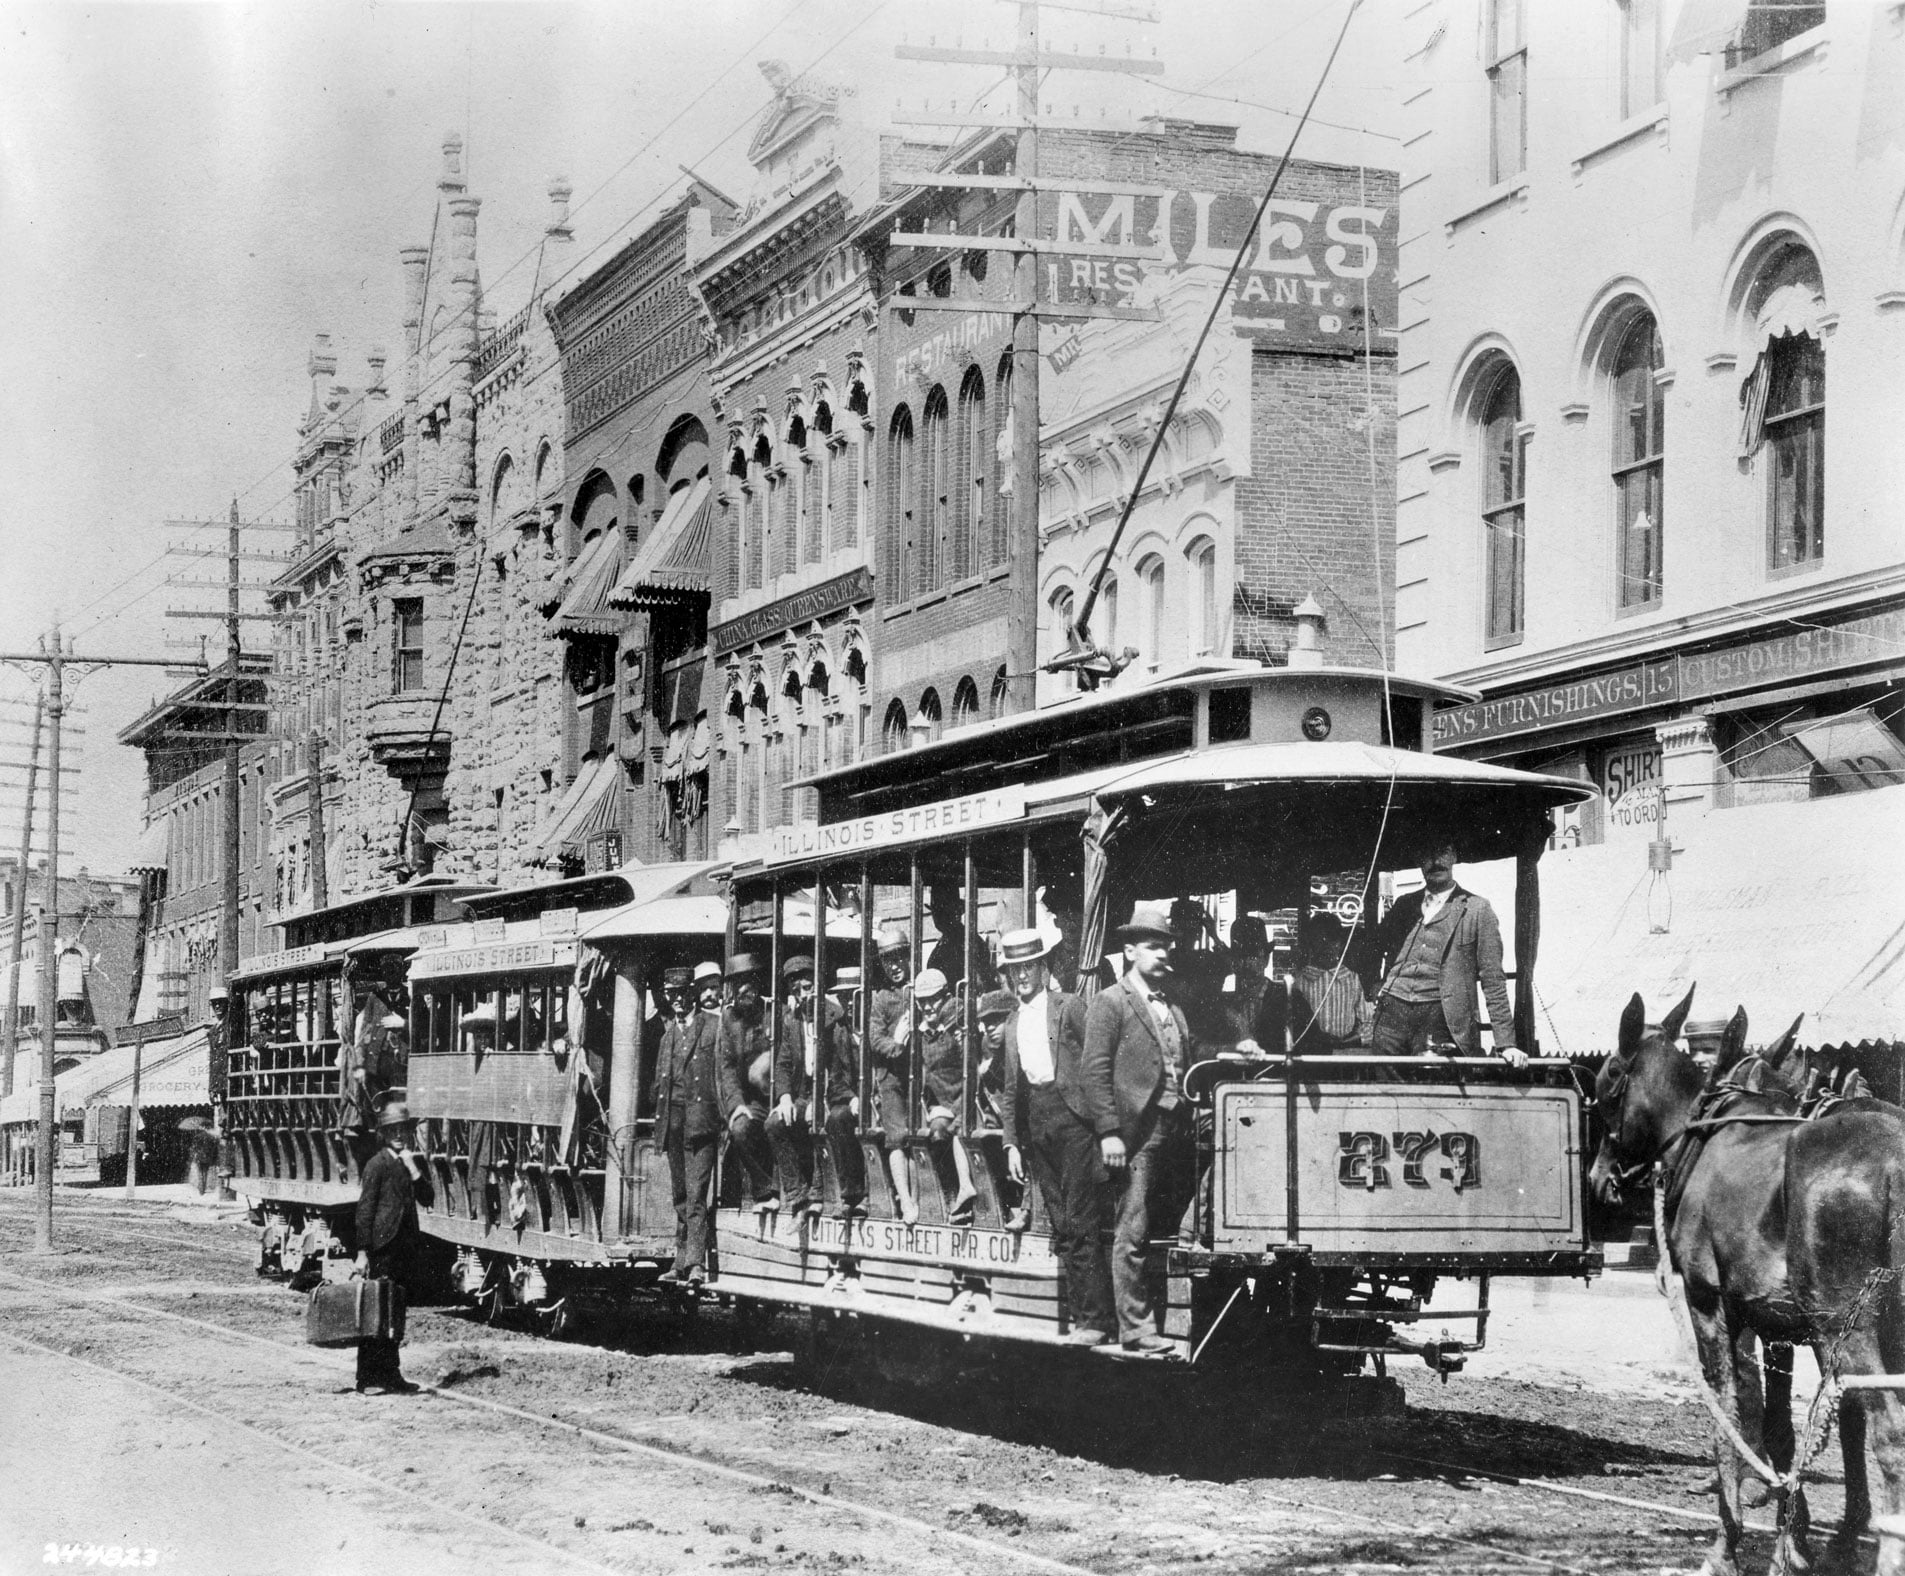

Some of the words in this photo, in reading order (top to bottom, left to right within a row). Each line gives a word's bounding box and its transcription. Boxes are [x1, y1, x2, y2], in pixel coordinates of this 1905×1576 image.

[1056, 189, 1389, 279] MILES
[1685, 641, 1790, 686] CUSTOM
[1482, 673, 1642, 730] FURNISHINGS.
[1648, 666, 1673, 696] 15
[781, 820, 875, 857] ILLINOIS
[891, 797, 987, 835] STREET
[1617, 807, 1632, 827] TO
[432, 951, 486, 973] ILLINOIS
[490, 944, 540, 967] STREET
[1338, 1129, 1483, 1192] 279
[810, 1217, 875, 1250] CITIZENS
[884, 1227, 942, 1256] STREET
[989, 1236, 1014, 1263] CO.
